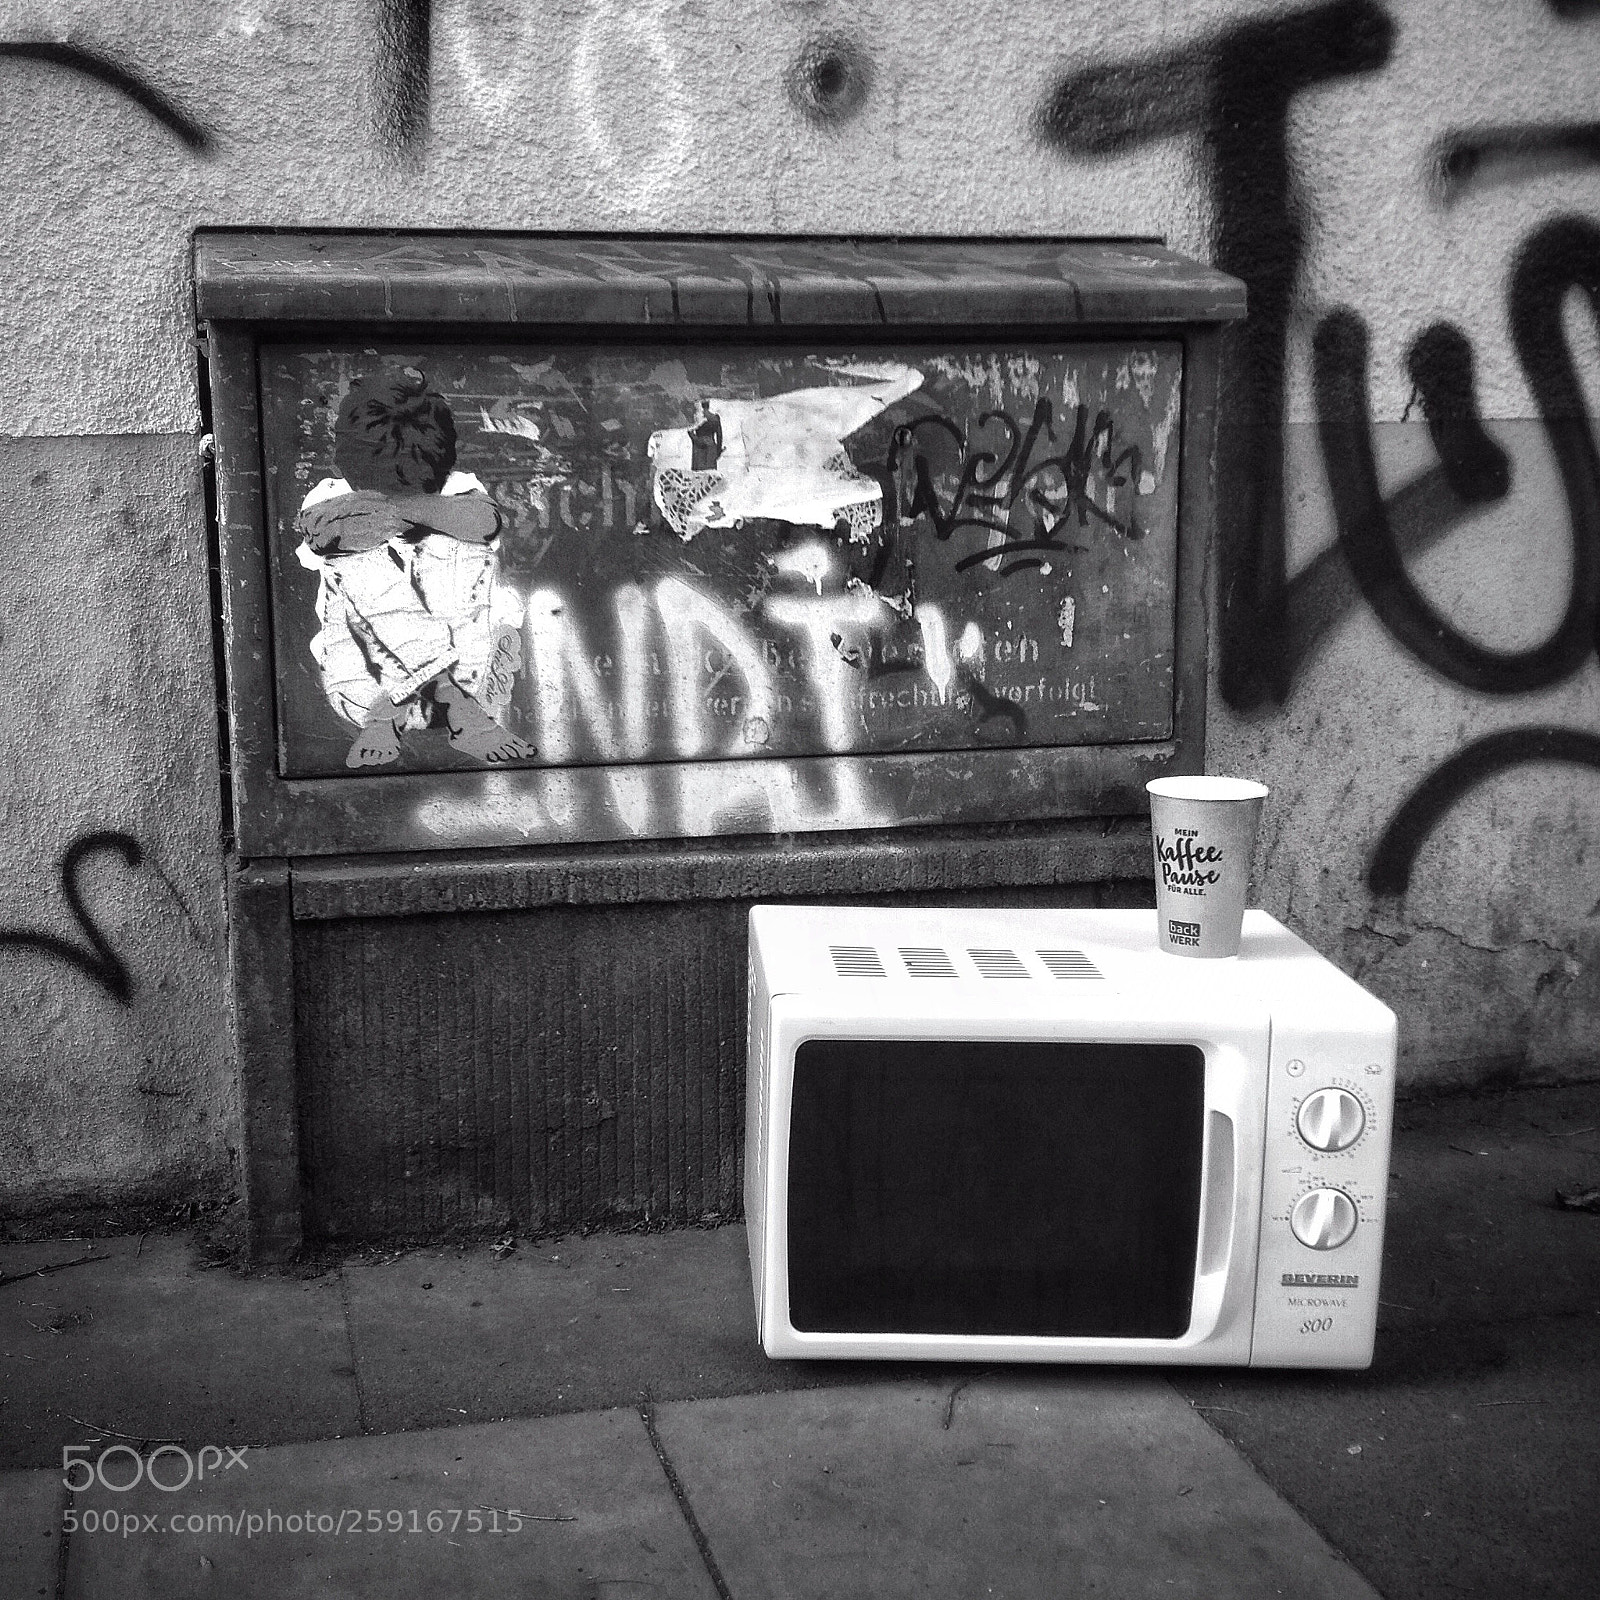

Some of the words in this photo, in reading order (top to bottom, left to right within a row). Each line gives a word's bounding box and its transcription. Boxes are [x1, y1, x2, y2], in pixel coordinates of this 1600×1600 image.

[1174, 828, 1198, 837] MEIN
[1162, 863, 1220, 886] Pause
[1167, 884, 1181, 894] FÜR
[1169, 920, 1200, 936] back
[1169, 934, 1199, 947] WERK
[1281, 1273, 1360, 1285] SEVERIN
[1287, 1298, 1347, 1308] MICROWAVE
[1299, 1317, 1334, 1334] 800
